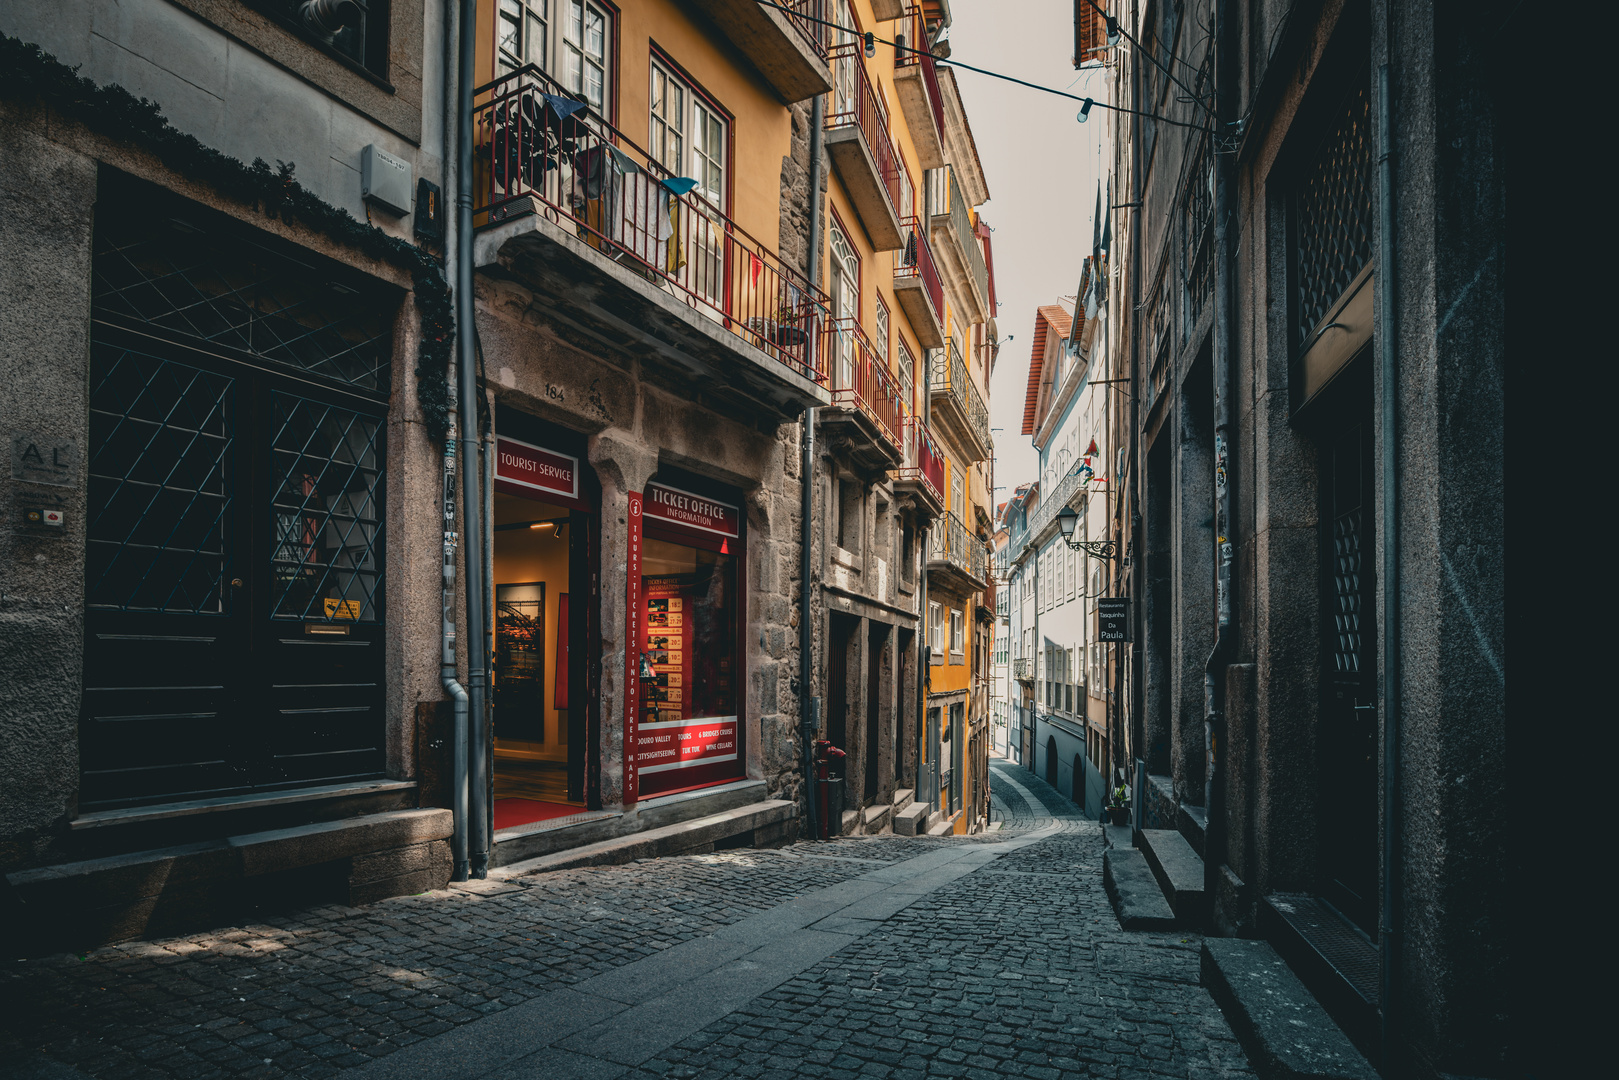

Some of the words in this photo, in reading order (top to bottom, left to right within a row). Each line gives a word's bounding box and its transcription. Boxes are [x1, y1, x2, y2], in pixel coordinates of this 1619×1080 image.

[544, 382, 565, 402] 184
[500, 452, 538, 472] TOURIST
[539, 463, 571, 482] SERVICE
[652, 488, 689, 510] TICKET
[691, 499, 724, 520] OFFICE
[666, 507, 712, 526] INFORMATION
[1101, 631, 1123, 639] Paula
[655, 735, 671, 743] VALLEY
[703, 730, 719, 738] BRIDGES
[706, 743, 716, 751] WINE
[717, 742, 732, 750] CELLARS
